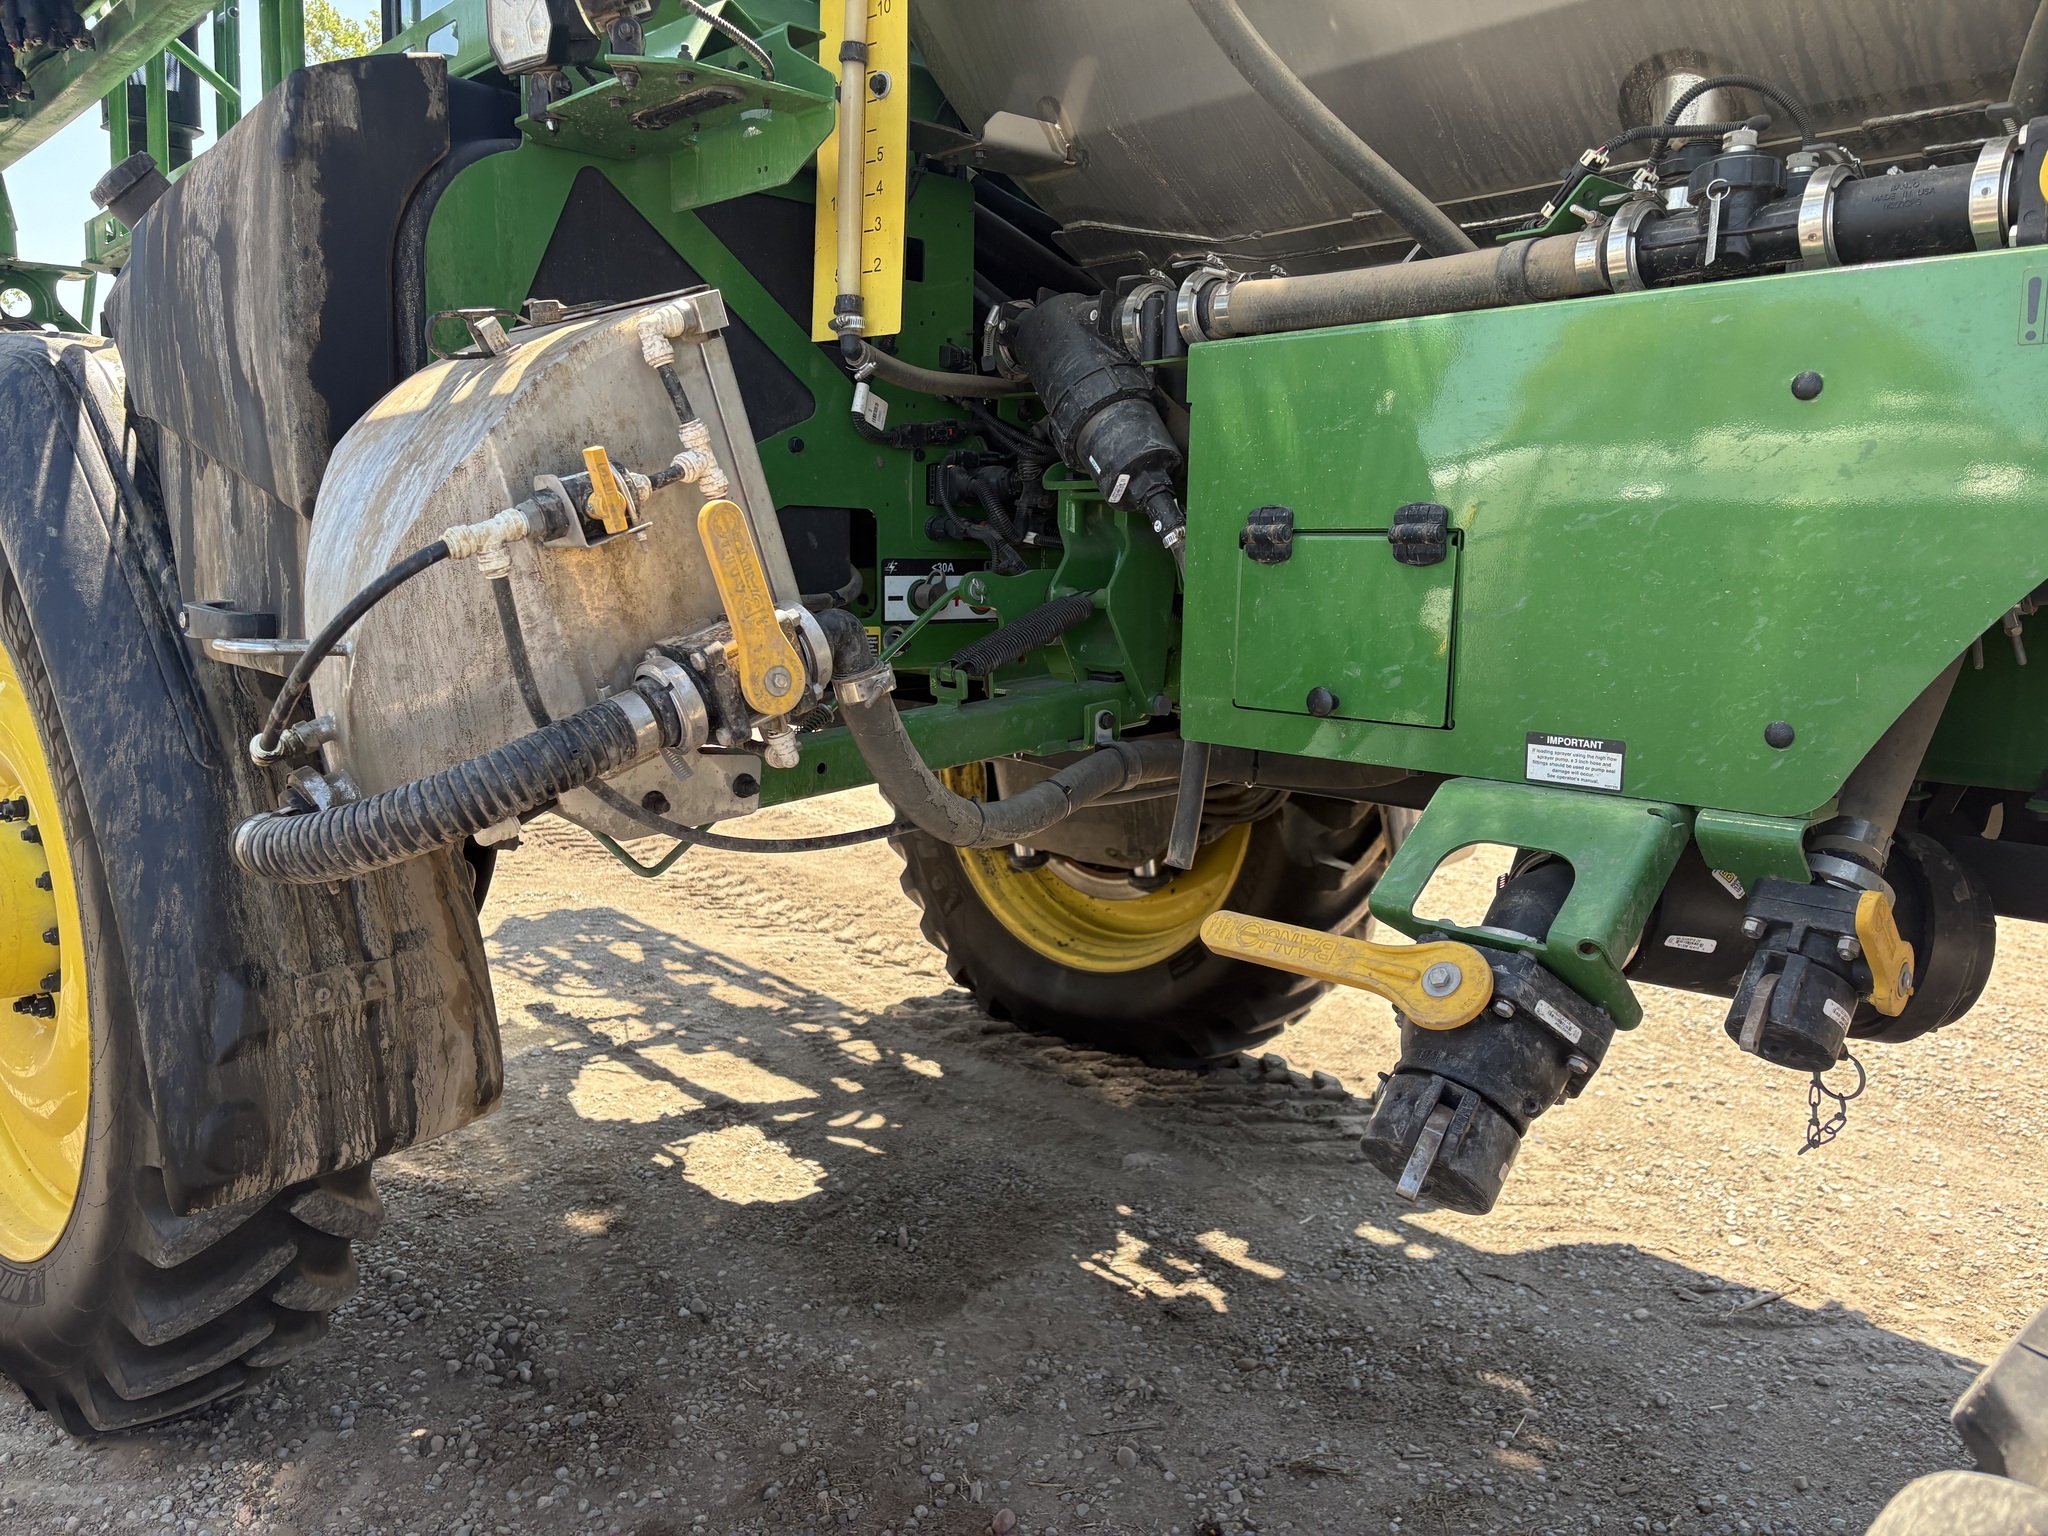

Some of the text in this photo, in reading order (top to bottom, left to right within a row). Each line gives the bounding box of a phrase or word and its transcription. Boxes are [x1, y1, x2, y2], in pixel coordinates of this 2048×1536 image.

[877, 0, 892, 16] 10
[876, 146, 884, 162] 5
[876, 180, 884, 195] 4
[1917, 187, 1936, 197] USA
[874, 216, 882, 232] 3
[873, 257, 882, 273] 2
[1546, 735, 1604, 750] IMPORTANT
[1556, 774, 1580, 782] operator's
[1235, 920, 1341, 966] BANJO
